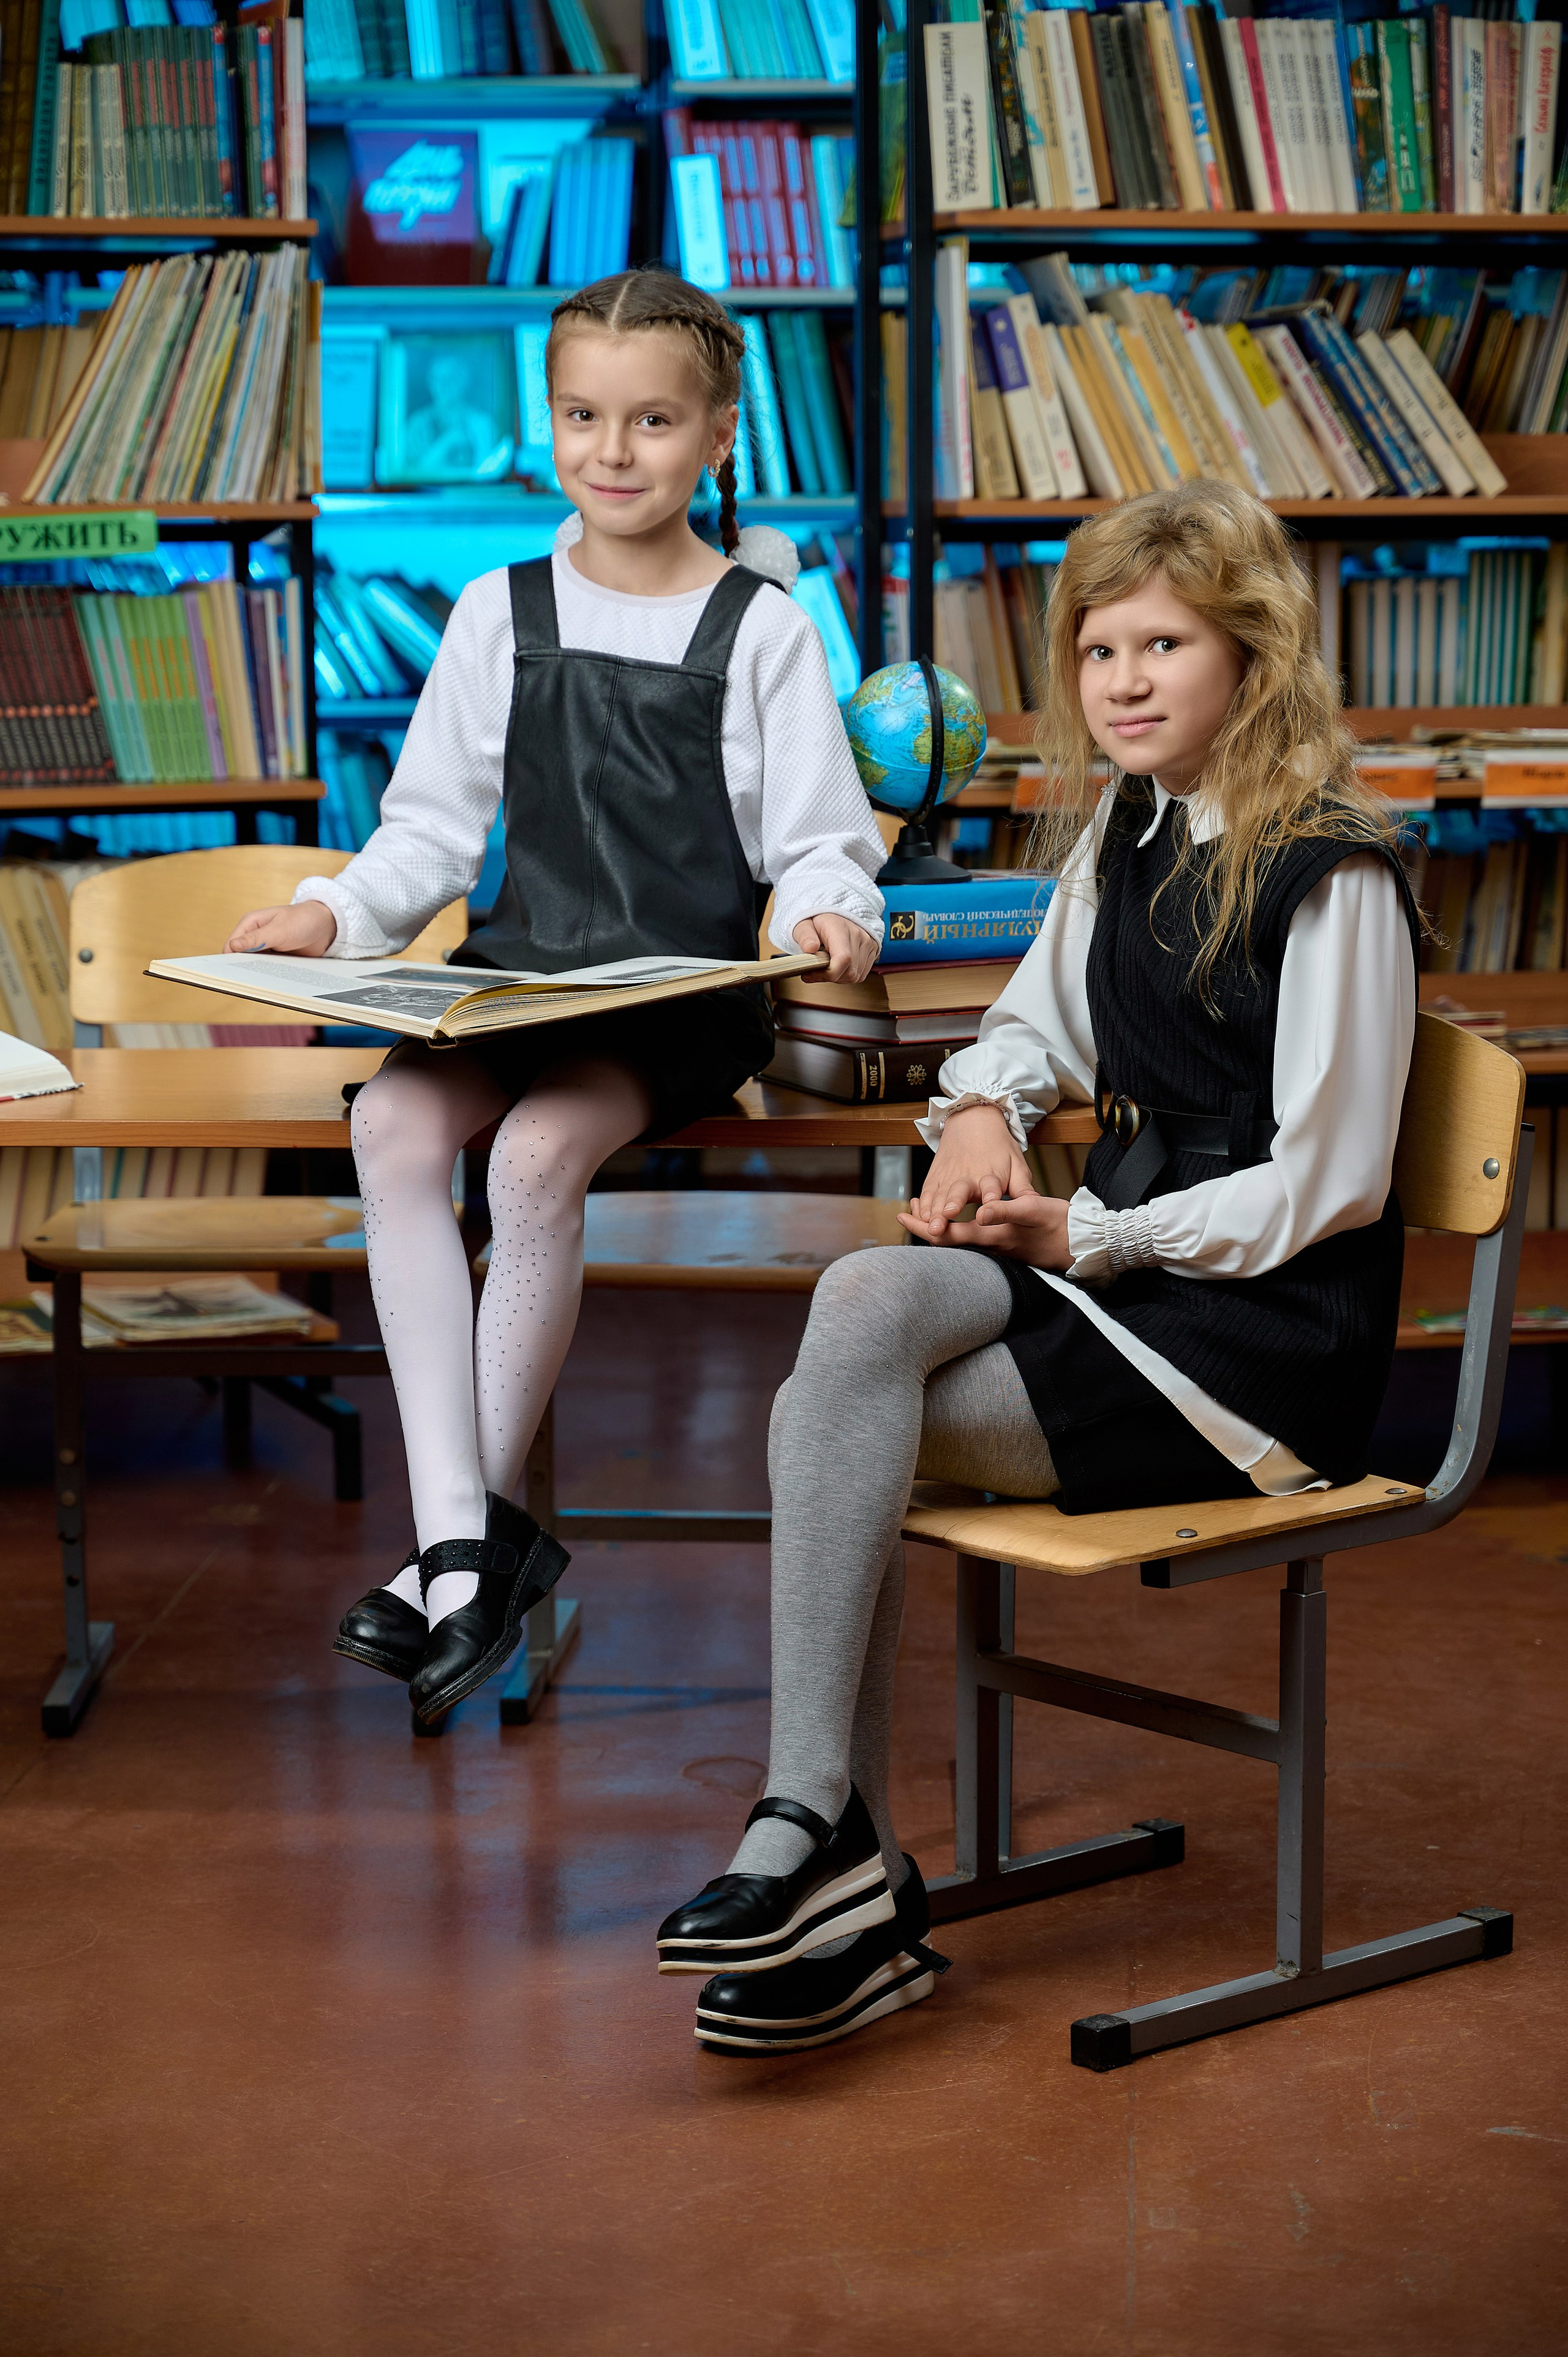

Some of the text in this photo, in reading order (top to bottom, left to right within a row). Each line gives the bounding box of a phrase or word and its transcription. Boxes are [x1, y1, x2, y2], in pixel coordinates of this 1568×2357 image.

[0, 521, 138, 552] УЖИТЬ
[923, 909, 1047, 922] ЛОПЕДИЧЕСКИЙ СЛОВАРЬ
